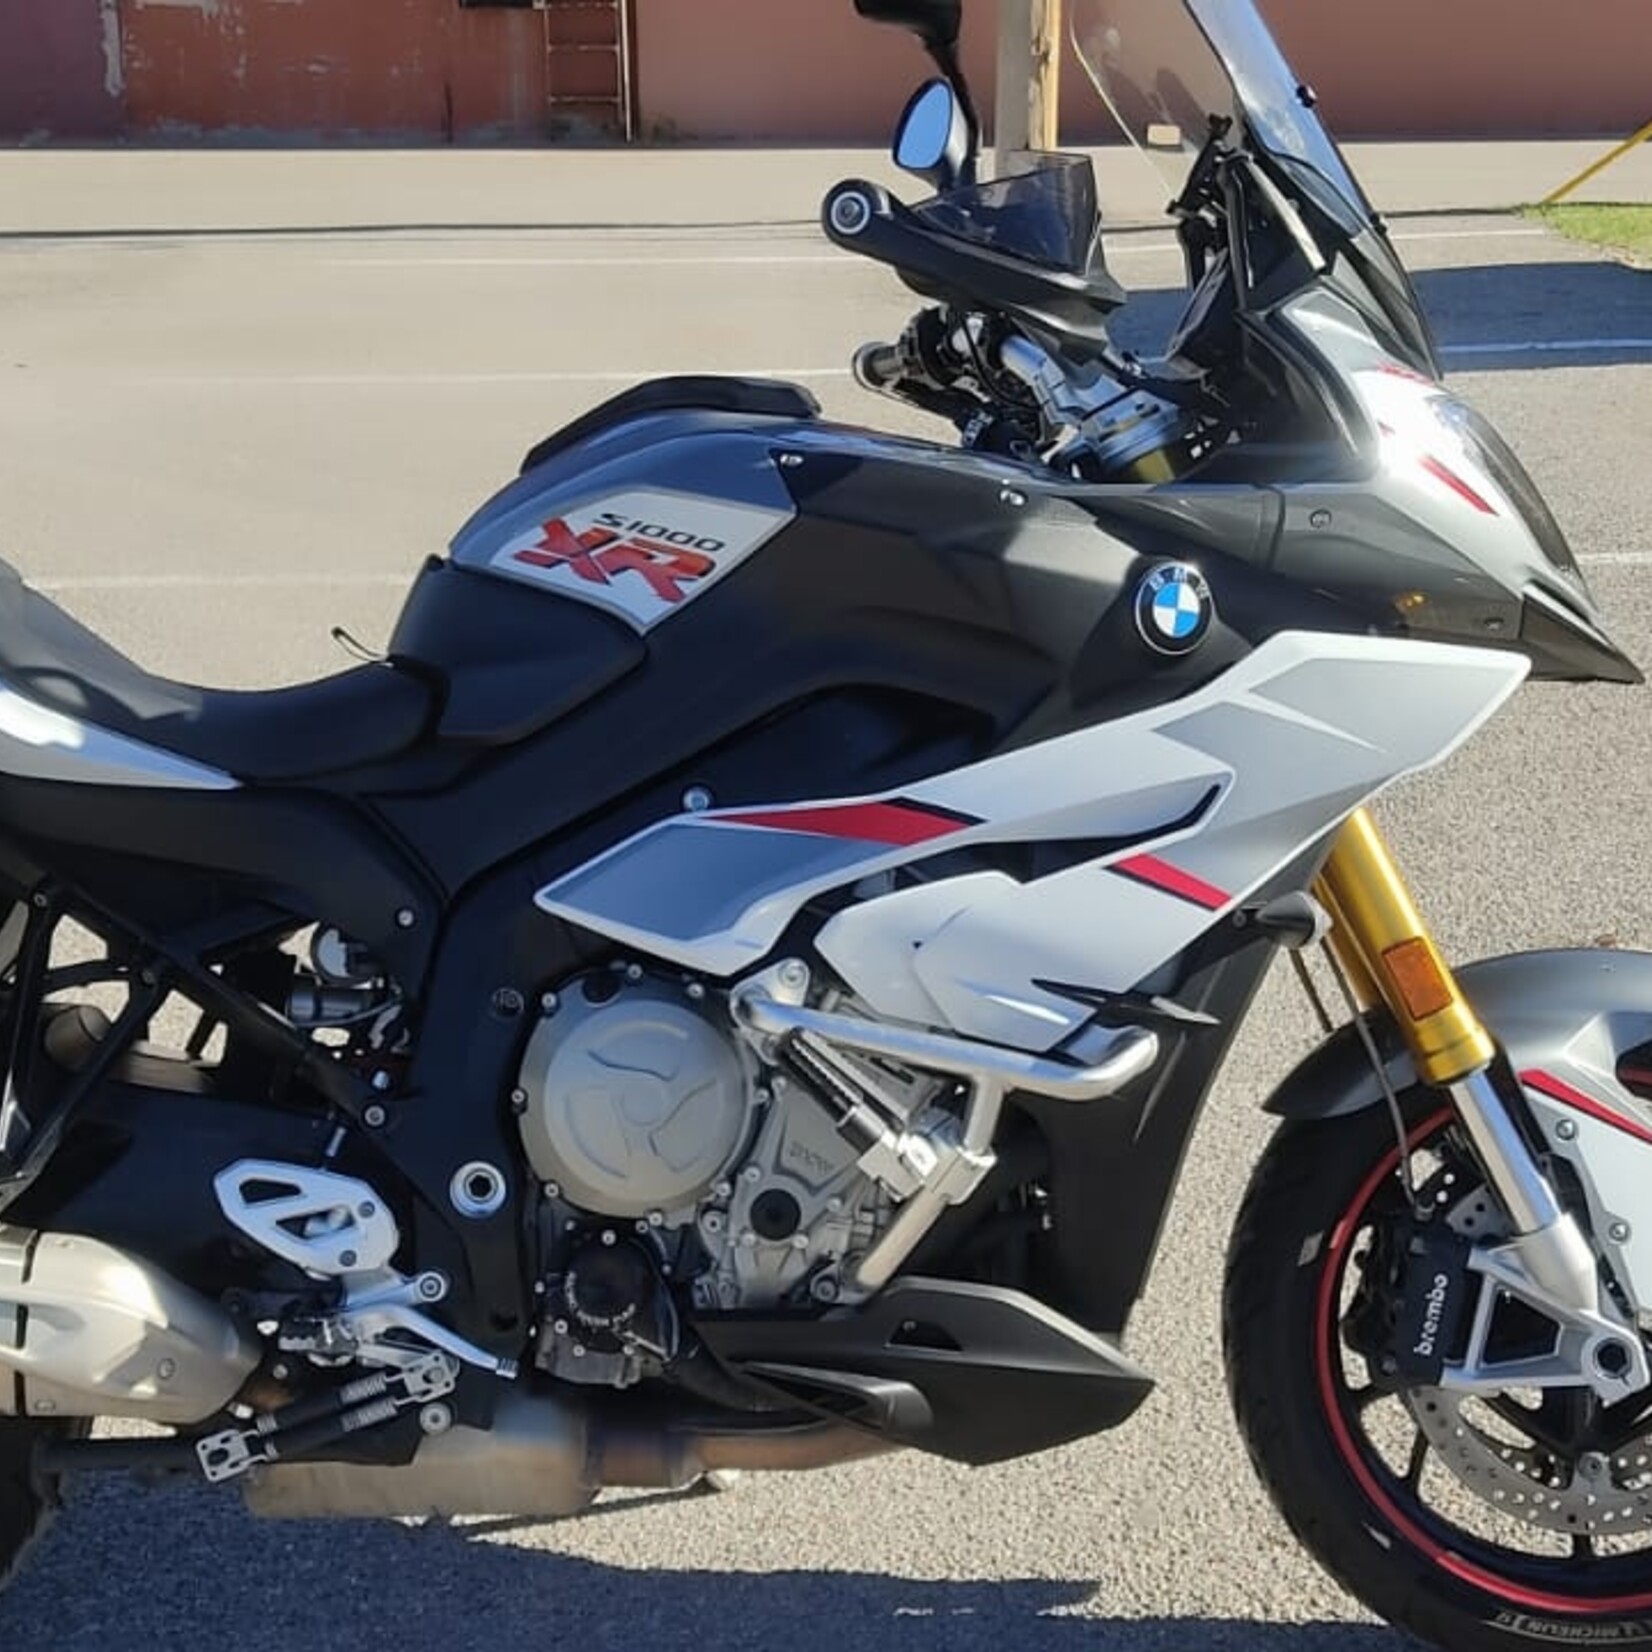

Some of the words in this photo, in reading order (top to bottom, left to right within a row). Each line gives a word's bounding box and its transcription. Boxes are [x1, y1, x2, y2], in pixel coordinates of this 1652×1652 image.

[594, 512, 725, 552] S1000
[513, 517, 717, 604] XR
[1149, 566, 1209, 600] BMW
[1413, 1273, 1448, 1355] brembo
[1527, 1620, 1620, 1639] MICHELIN
